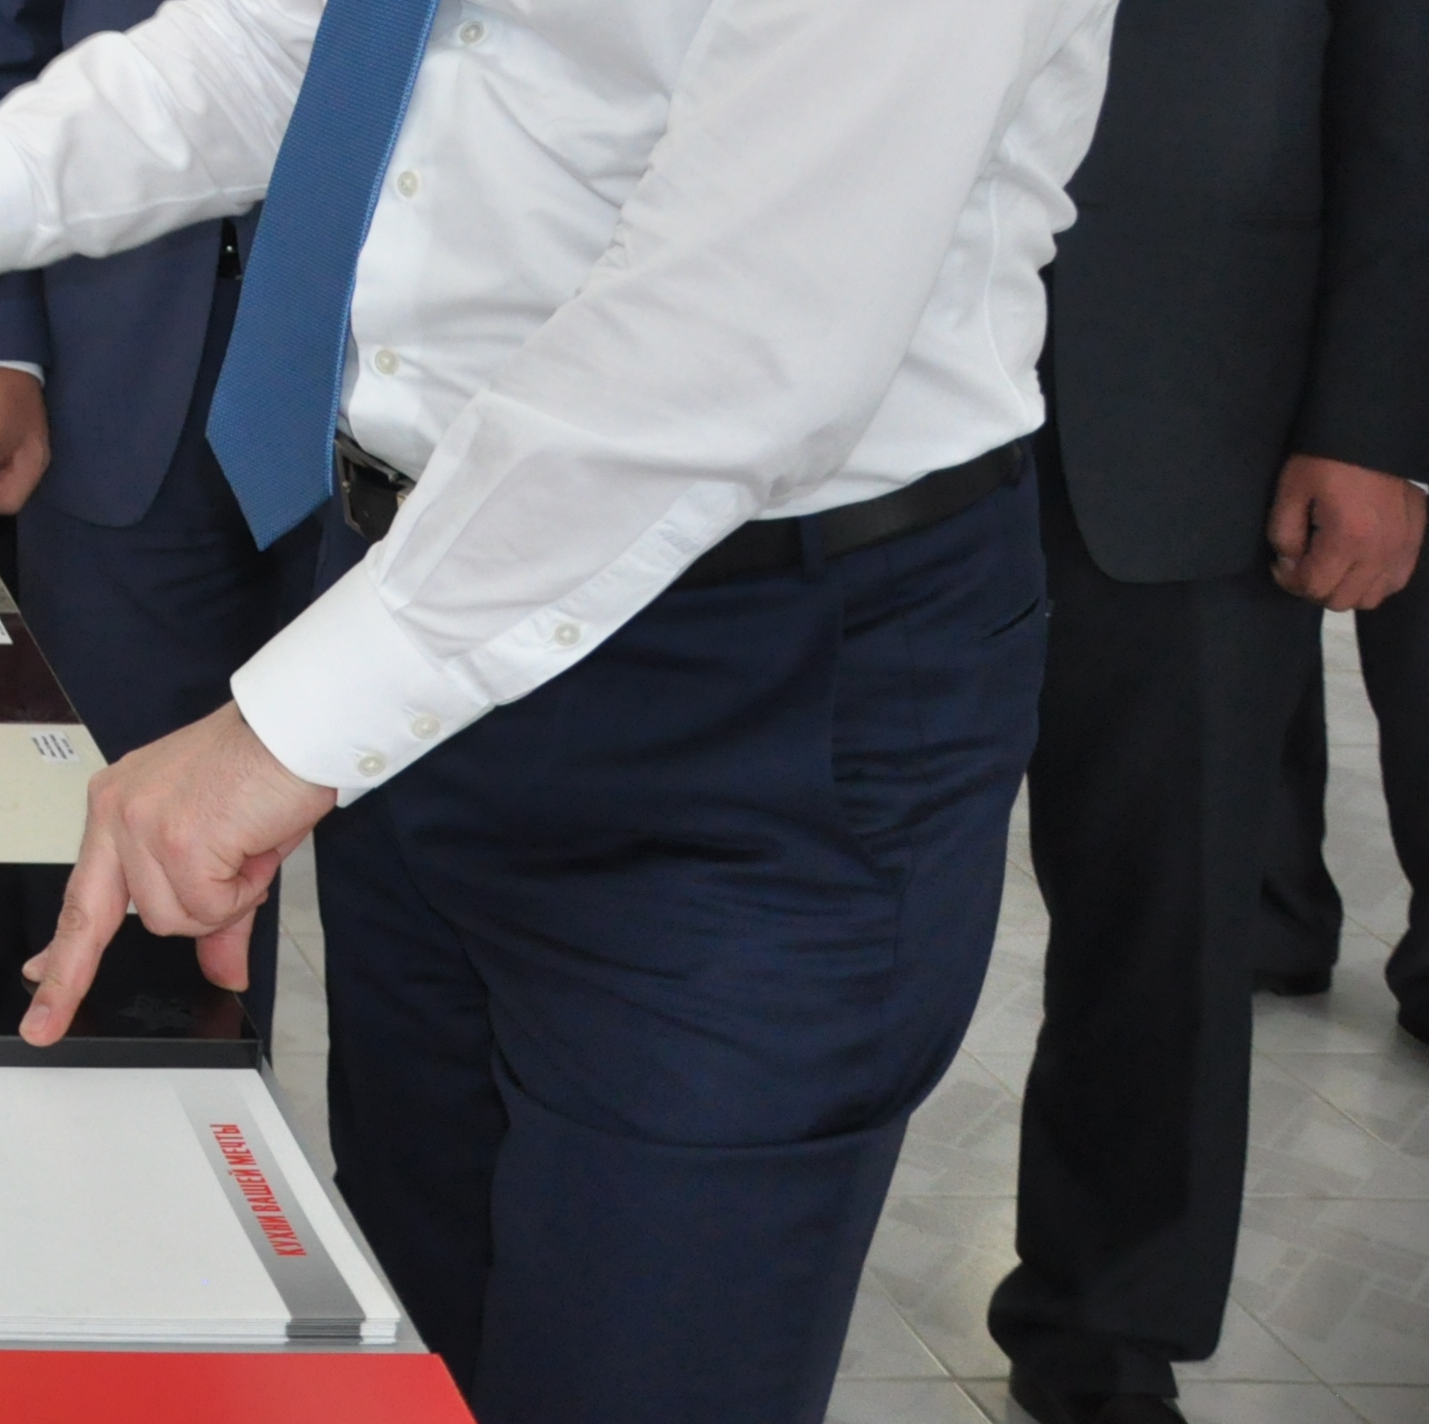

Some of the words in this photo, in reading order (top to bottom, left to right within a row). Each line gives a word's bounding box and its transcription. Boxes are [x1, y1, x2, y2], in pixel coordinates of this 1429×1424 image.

[209, 1123, 257, 1166] МЕЧТЫ
[226, 1168, 282, 1212] ВАШЕЙ
[255, 1214, 307, 1257] КУХНИ
